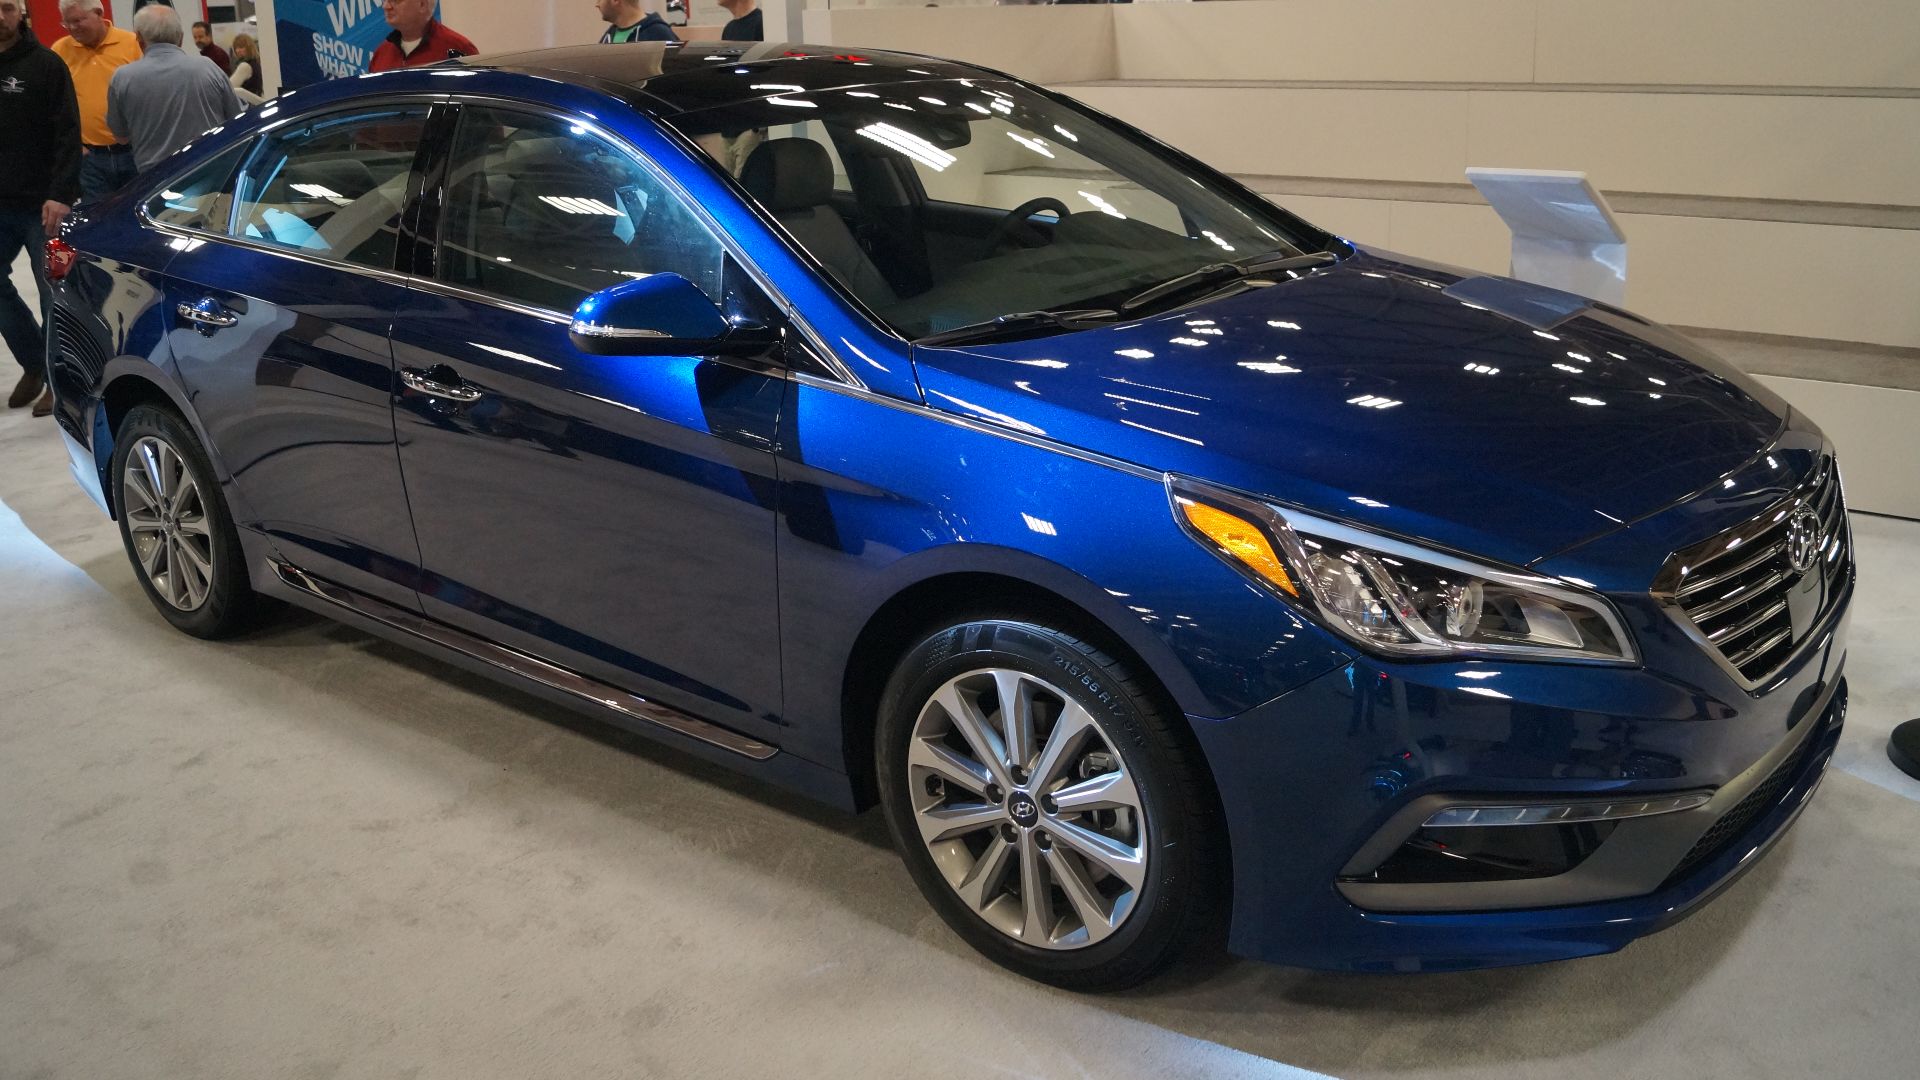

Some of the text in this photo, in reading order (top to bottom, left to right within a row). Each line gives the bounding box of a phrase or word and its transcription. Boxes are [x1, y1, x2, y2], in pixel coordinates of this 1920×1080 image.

[312, 32, 363, 66] SHOW
[315, 50, 357, 78] WHAT
[1054, 656, 1100, 693] 215/55
